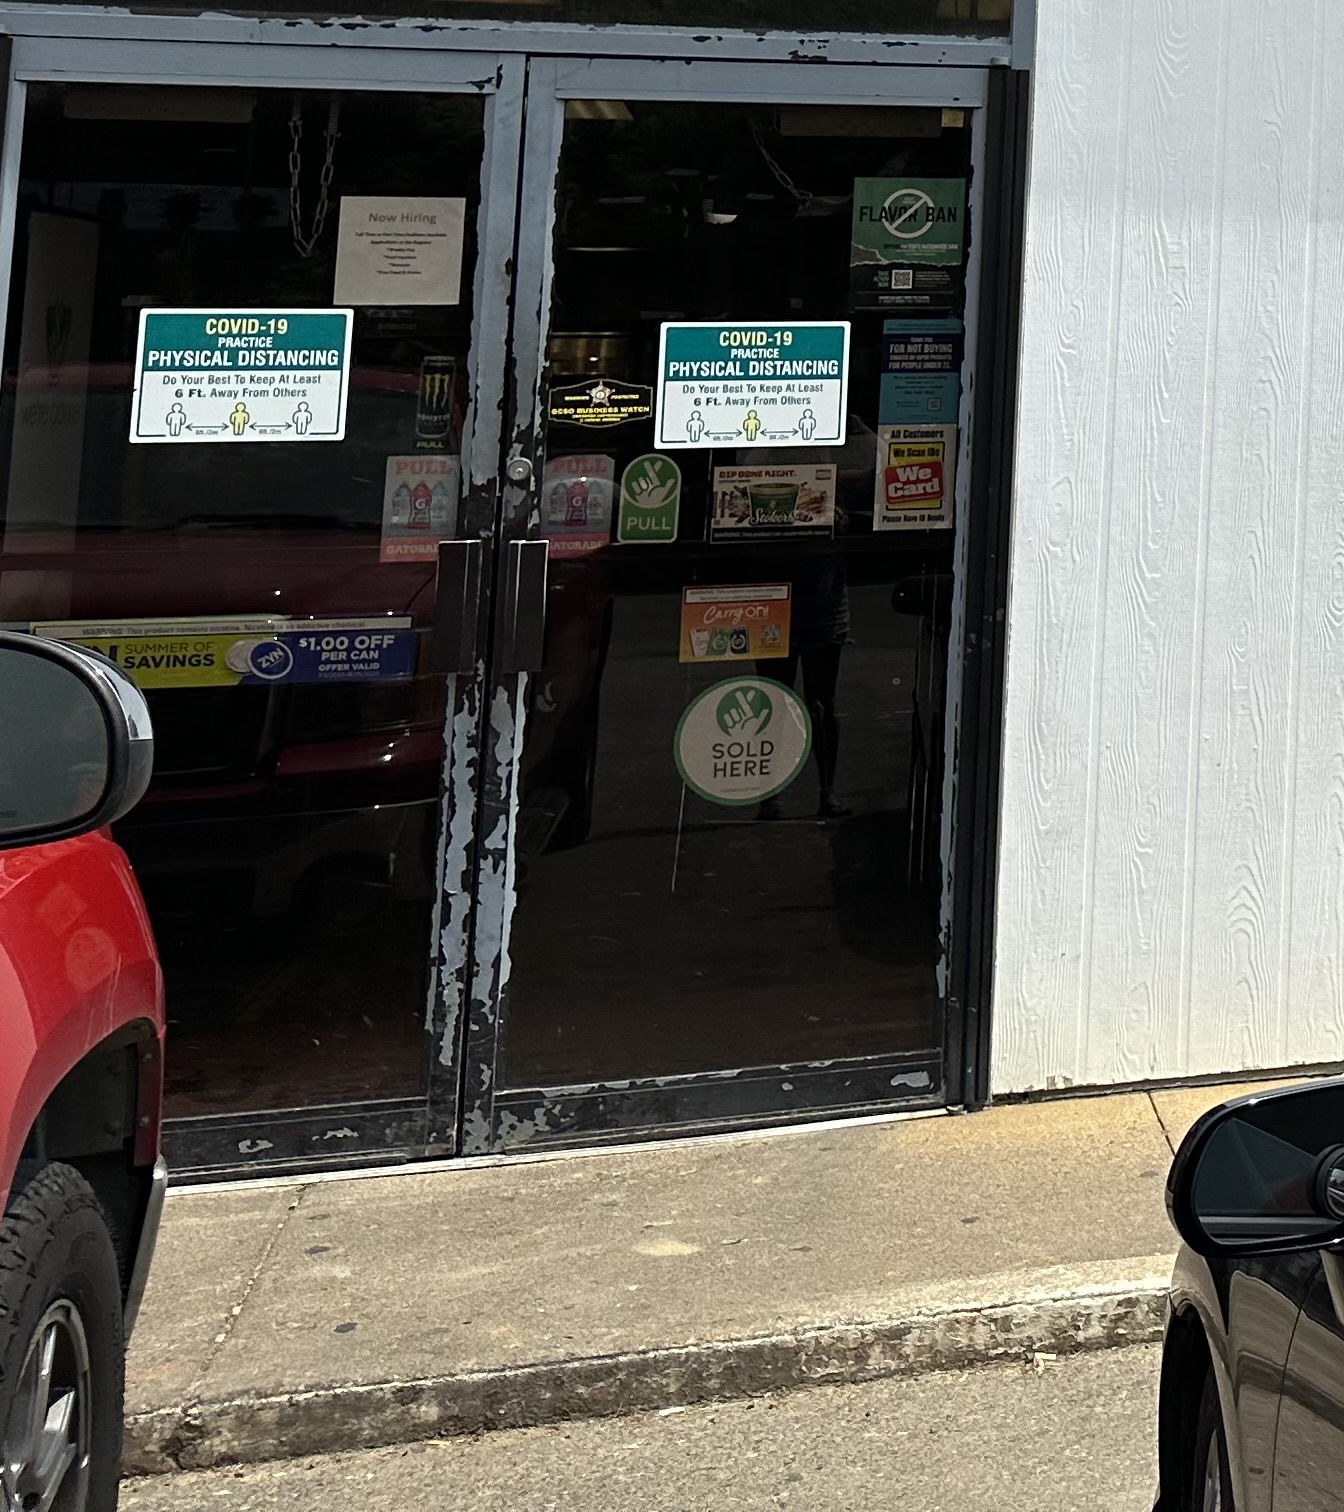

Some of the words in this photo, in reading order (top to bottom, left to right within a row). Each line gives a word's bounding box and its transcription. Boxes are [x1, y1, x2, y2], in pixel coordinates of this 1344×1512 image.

[368, 212, 397, 223] Now
[401, 212, 437, 225] Hiring
[859, 206, 918, 223] FLAVOR
[925, 206, 958, 223] BAN
[206, 318, 288, 335] COVID-19
[217, 337, 273, 348] PRACTICE
[719, 331, 793, 347] COVID-19
[147, 350, 233, 367] PHYSICAL
[237, 349, 339, 366] DISTANCING
[730, 348, 780, 359] PRACTICE
[669, 361, 745, 377] PHYSICAL
[749, 360, 839, 376] DISTANCING
[162, 375, 178, 385] Do
[181, 375, 204, 385] Your
[207, 375, 231, 385] Best
[235, 375, 246, 385] To
[249, 374, 275, 386] Keep
[278, 374, 291, 384] At
[293, 374, 322, 384] Least
[174, 389, 184, 398] 6
[188, 389, 207, 398] Ft.
[210, 388, 239, 399] Away
[242, 388, 269, 397] From
[272, 387, 308, 397] Others
[682, 384, 697, 394] Do
[698, 384, 719, 394] Your
[722, 384, 743, 394] Best
[746, 384, 756, 393] To
[759, 383, 783, 395] Keep
[785, 383, 796, 393] At
[798, 383, 824, 393] Least
[693, 397, 702, 406] 6
[706, 397, 722, 406] Ft.
[725, 396, 751, 407] Away
[753, 396, 778, 406] From
[780, 395, 812, 405] Others
[903, 429, 945, 439] Customers
[395, 460, 451, 476] PULL
[552, 458, 608, 473] PULL
[895, 466, 933, 483] We
[888, 477, 941, 498] Card
[626, 516, 672, 531] PULL
[385, 543, 440, 555] GATORA
[703, 605, 744, 625] Carry
[125, 642, 188, 655] SUMMER
[194, 641, 215, 651] OF
[299, 636, 349, 651] $1.00
[354, 634, 396, 649] OFF
[123, 653, 215, 669] SAVINGS
[256, 647, 285, 669] ZYN
[321, 651, 347, 661] PER
[350, 650, 379, 660] CAN
[318, 664, 350, 672] OFFER
[352, 663, 380, 671] VALID
[712, 740, 774, 759] SOLD
[713, 759, 772, 778] HERE
